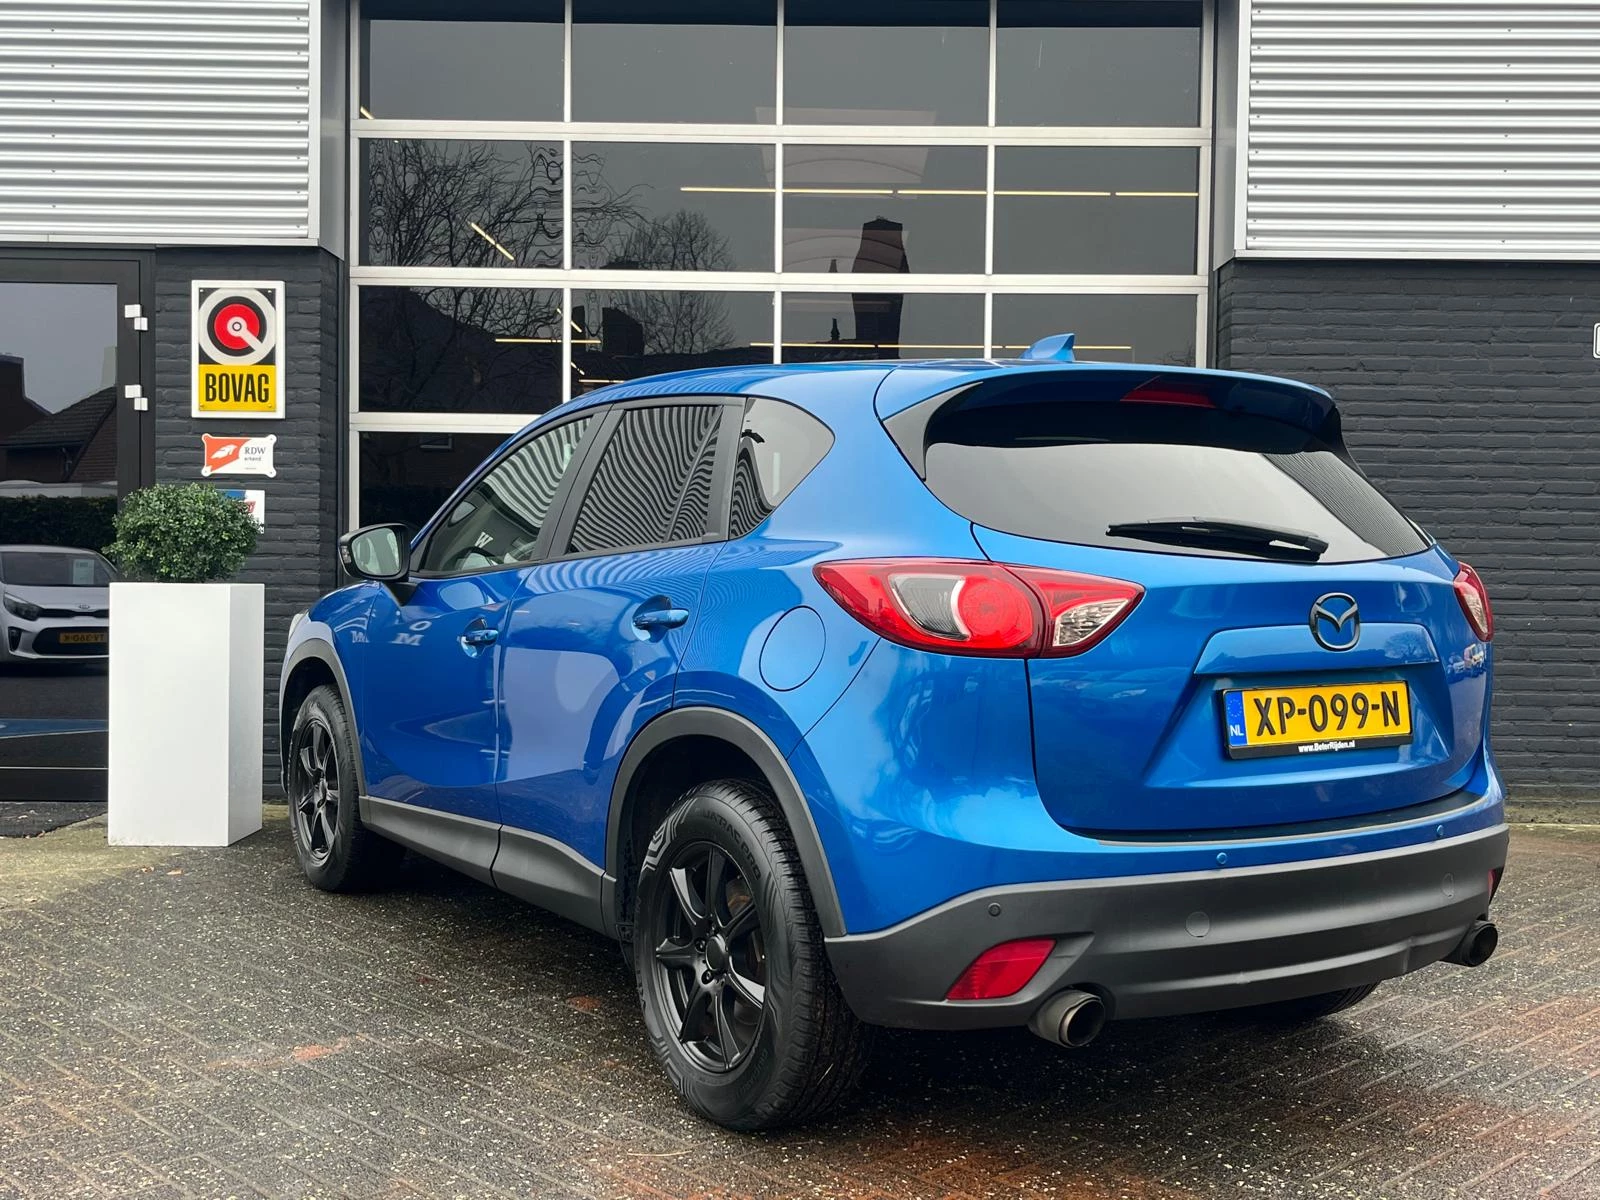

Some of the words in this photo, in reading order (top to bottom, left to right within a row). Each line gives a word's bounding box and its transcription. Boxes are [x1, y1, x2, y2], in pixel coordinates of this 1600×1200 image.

[205, 373, 269, 402] BOVAG
[244, 446, 266, 455] RDW
[1253, 691, 1400, 736] XP-099-N
[1230, 725, 1244, 736] NL
